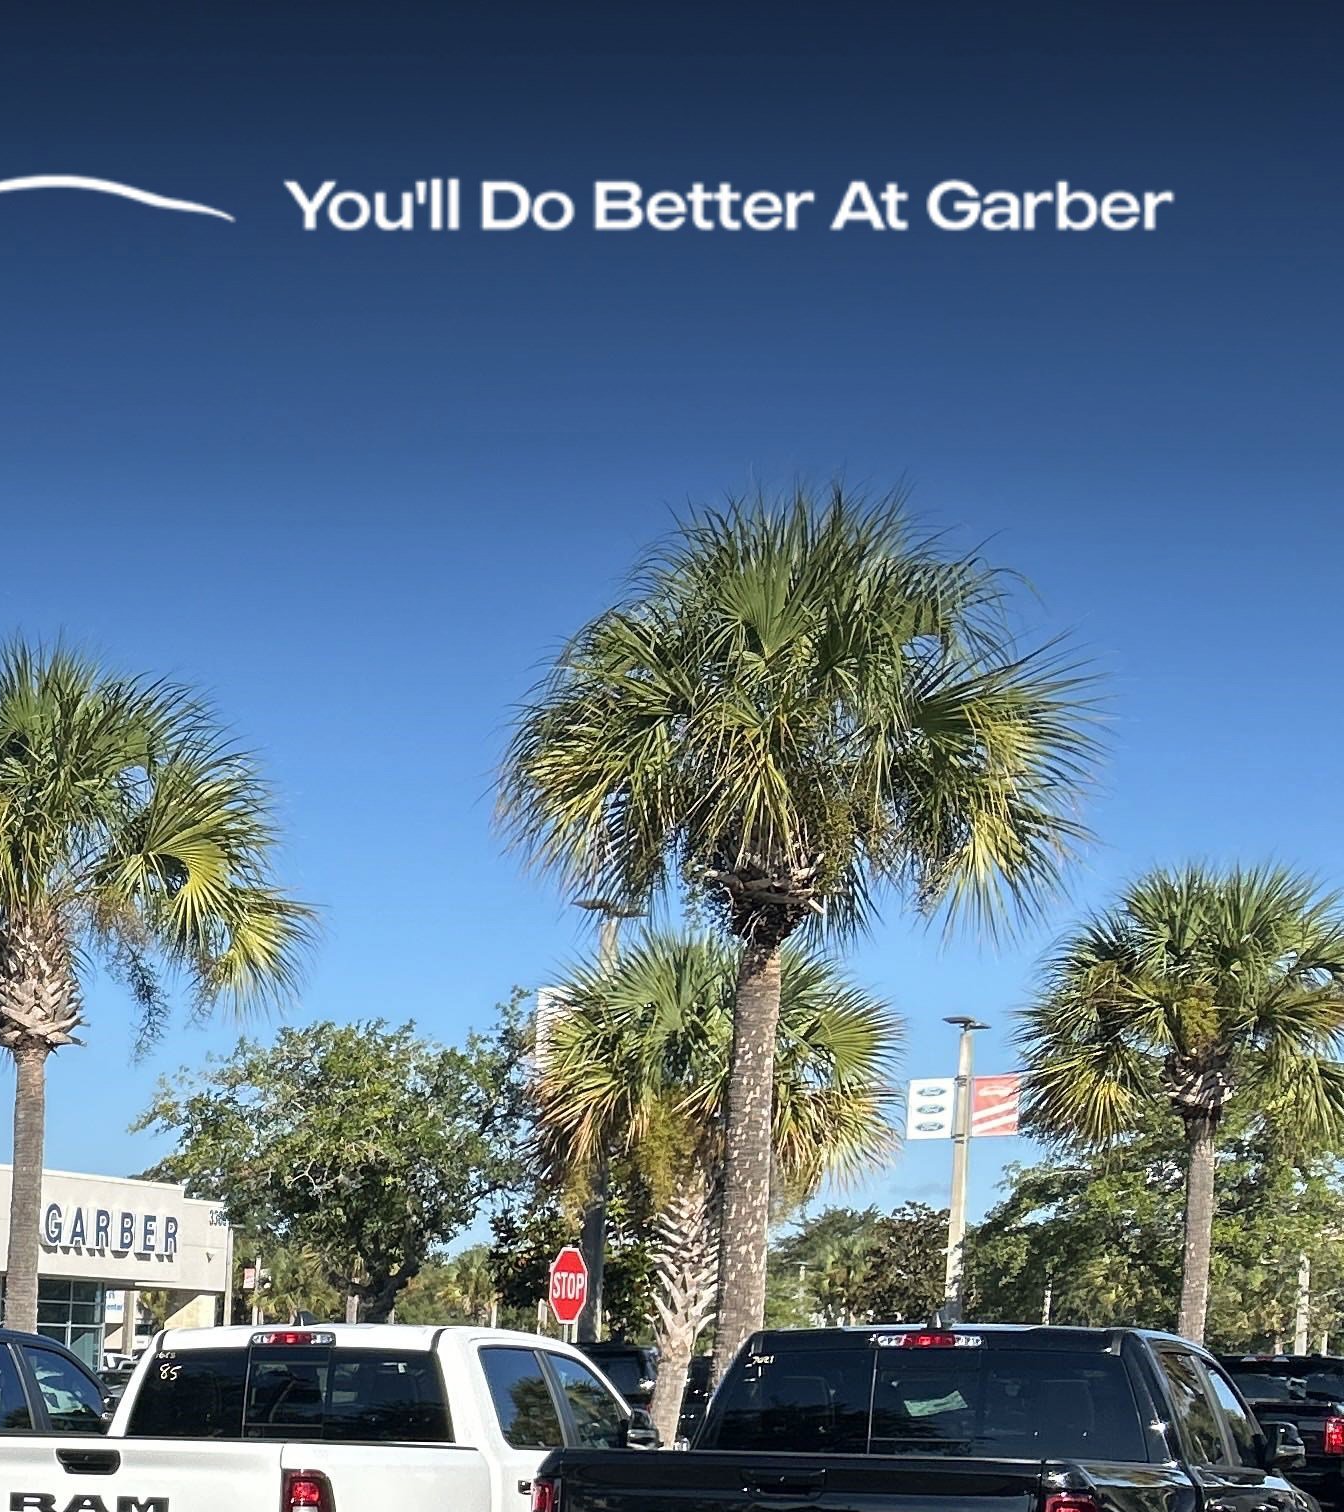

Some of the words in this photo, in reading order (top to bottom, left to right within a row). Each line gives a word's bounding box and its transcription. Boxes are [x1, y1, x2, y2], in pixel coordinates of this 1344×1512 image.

[44, 1202, 180, 1254] GARBER
[552, 1271, 585, 1300] STOP
[159, 1362, 183, 1381] 85
